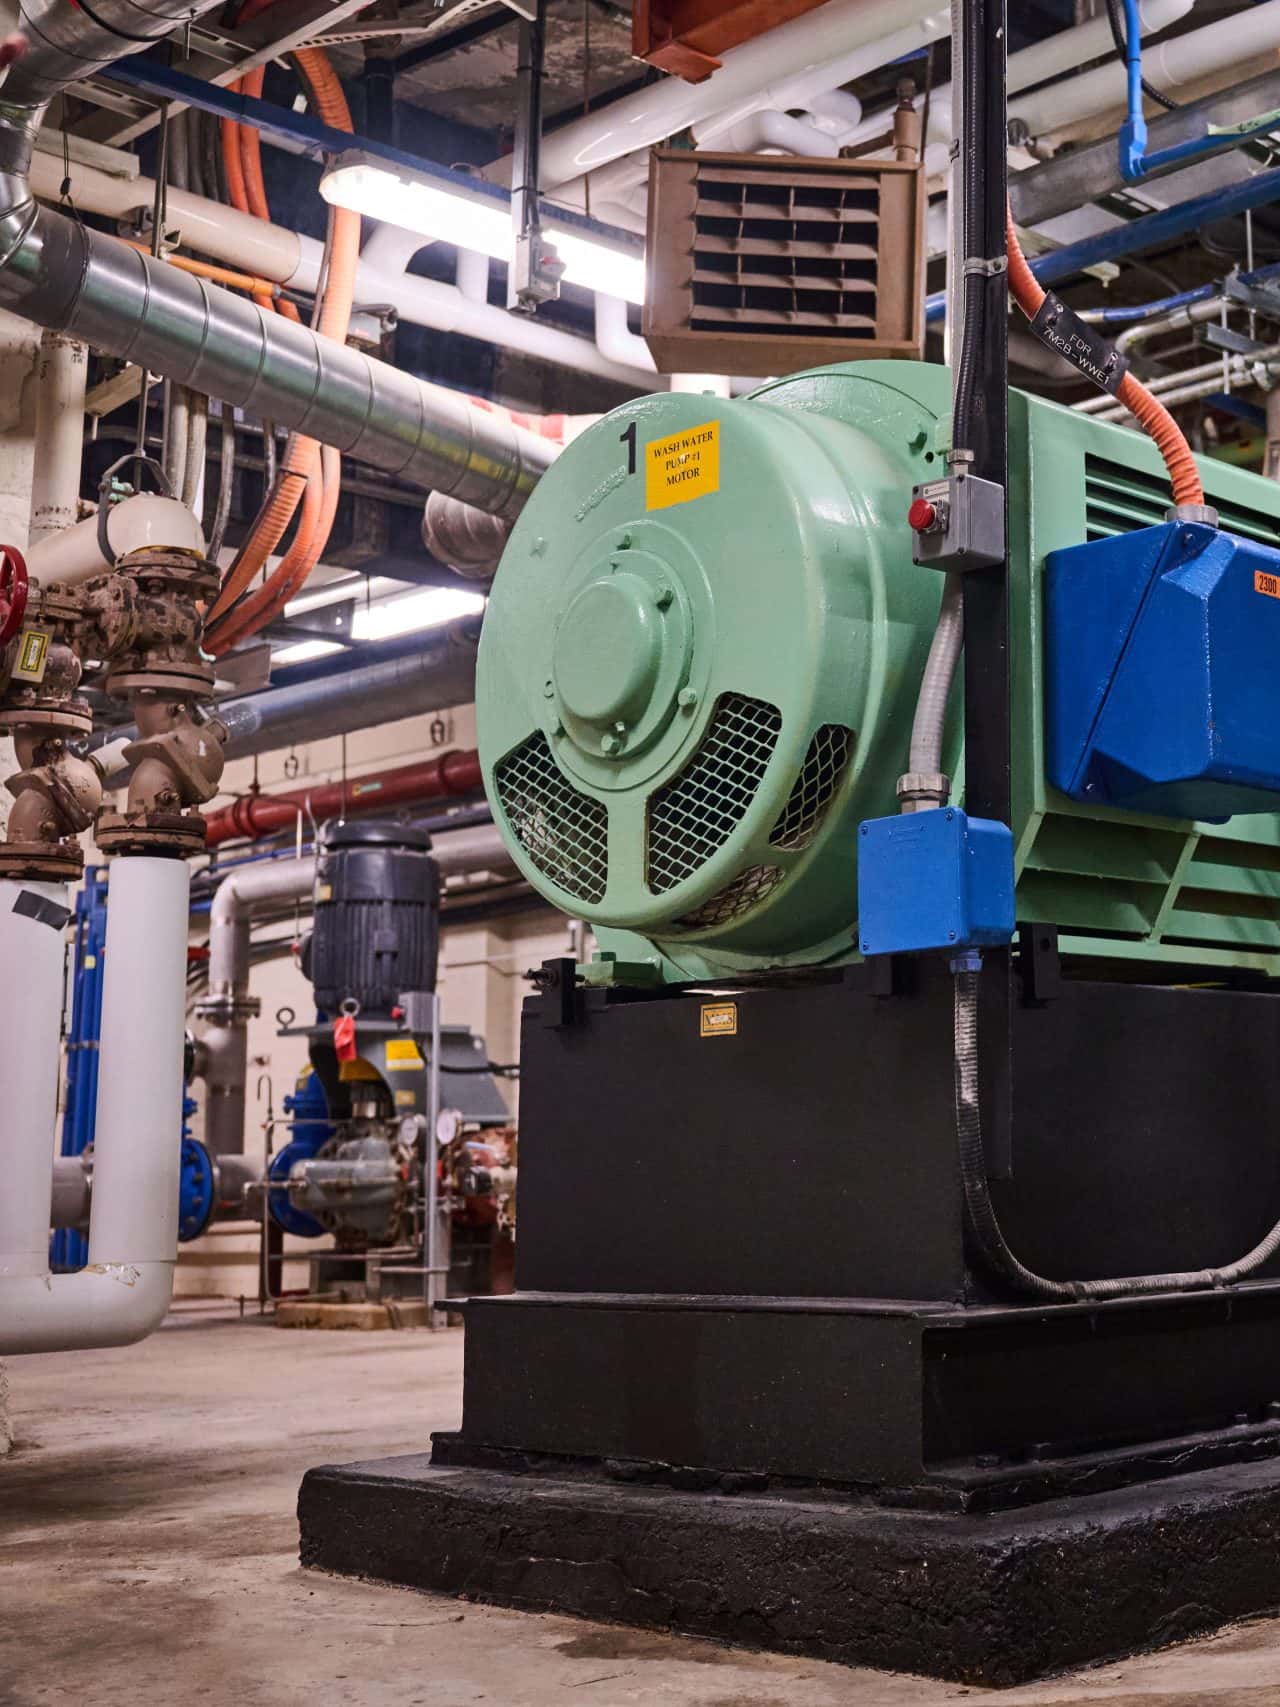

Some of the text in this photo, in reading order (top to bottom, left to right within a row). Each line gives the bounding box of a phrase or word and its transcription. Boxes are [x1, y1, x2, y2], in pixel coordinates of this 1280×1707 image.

[620, 421, 636, 475] 1
[653, 430, 713, 458] WASH WATER
[665, 453, 690, 471] PUMP
[666, 467, 700, 486] MOTOR
[1259, 575, 1277, 594] 2300
